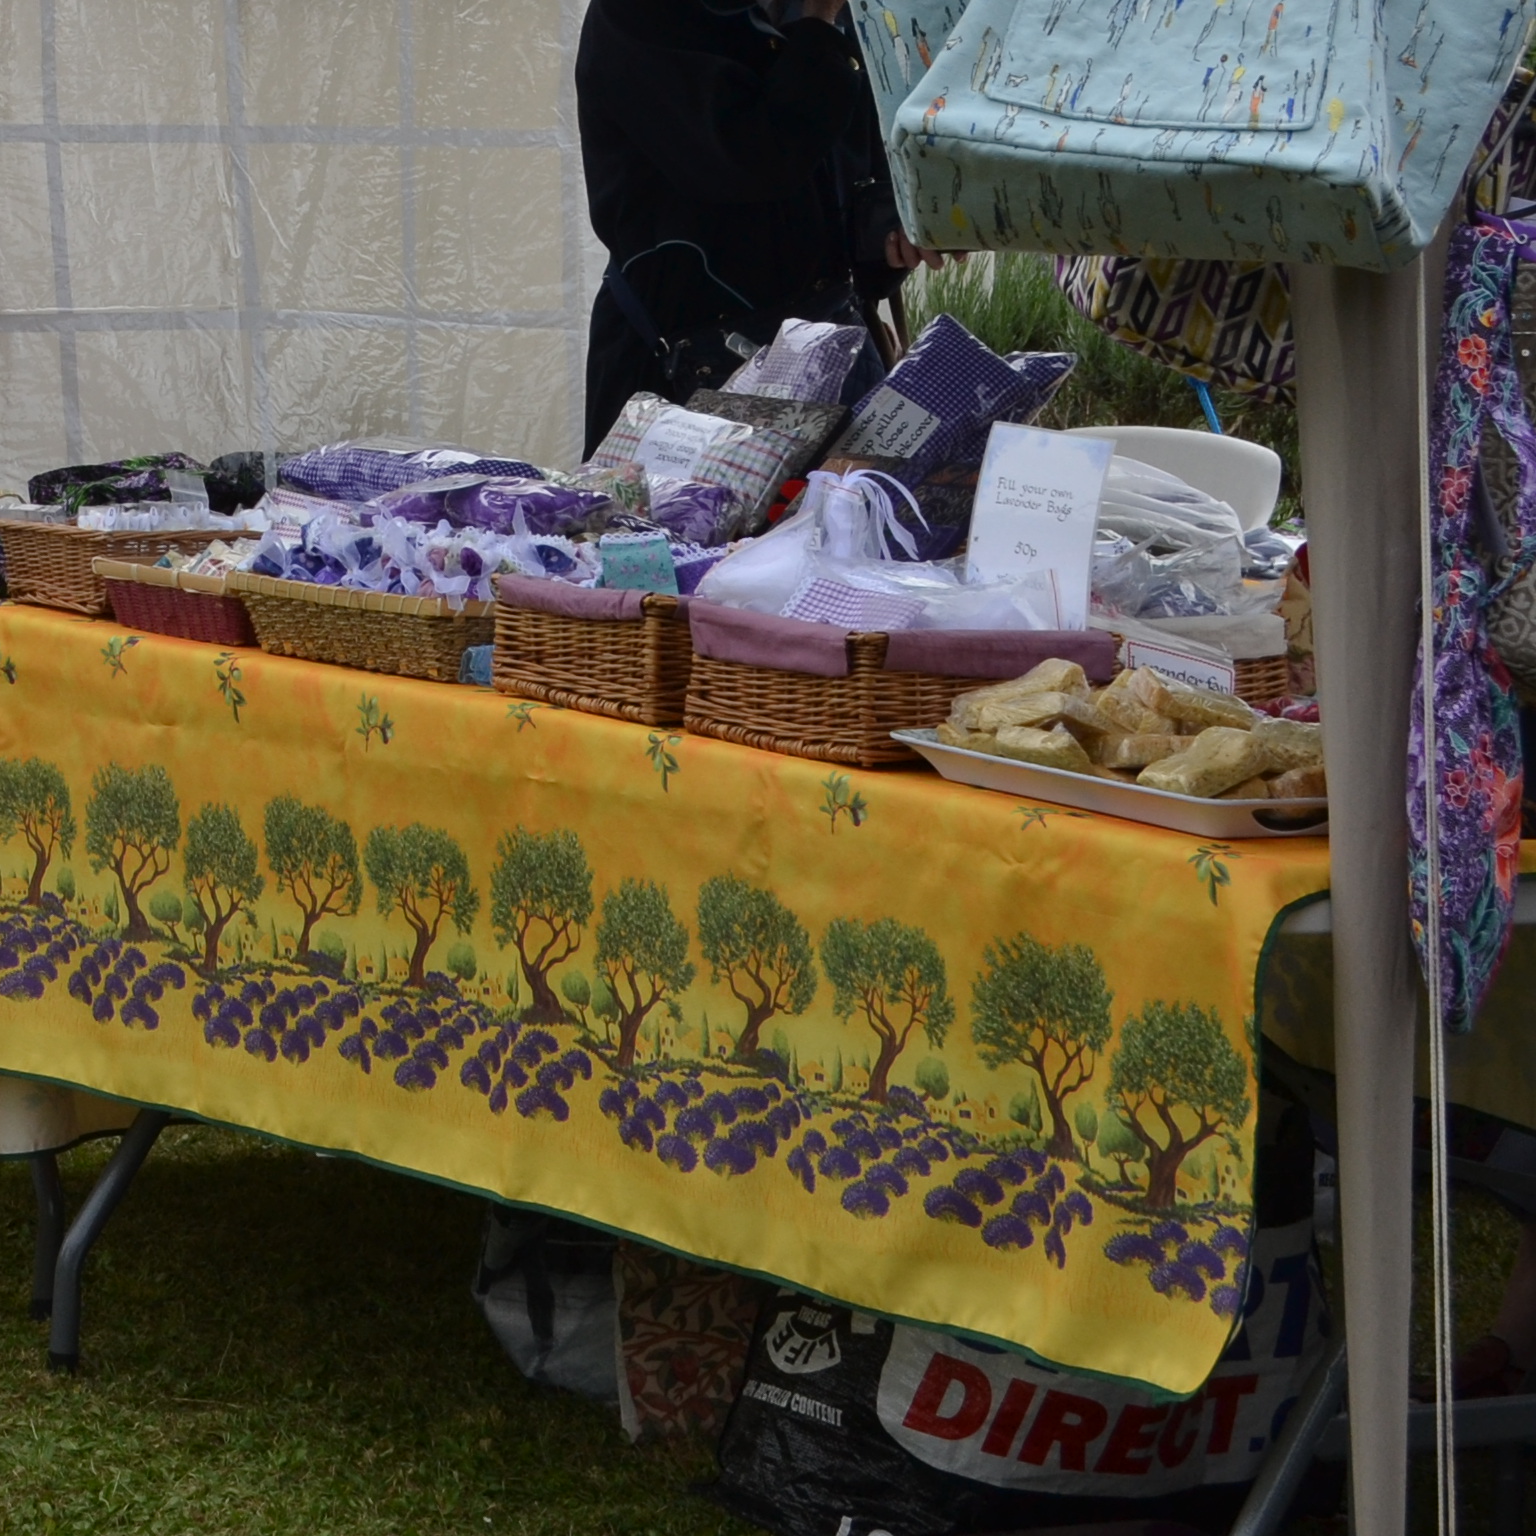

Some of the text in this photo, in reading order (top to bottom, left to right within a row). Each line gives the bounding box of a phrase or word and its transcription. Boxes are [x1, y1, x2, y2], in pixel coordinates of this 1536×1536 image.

[997, 476, 1074, 500] Fill your own
[995, 492, 1072, 522] Lavender Bags
[1014, 541, 1038, 564] 50p
[790, 1393, 843, 1427] CONTENT
